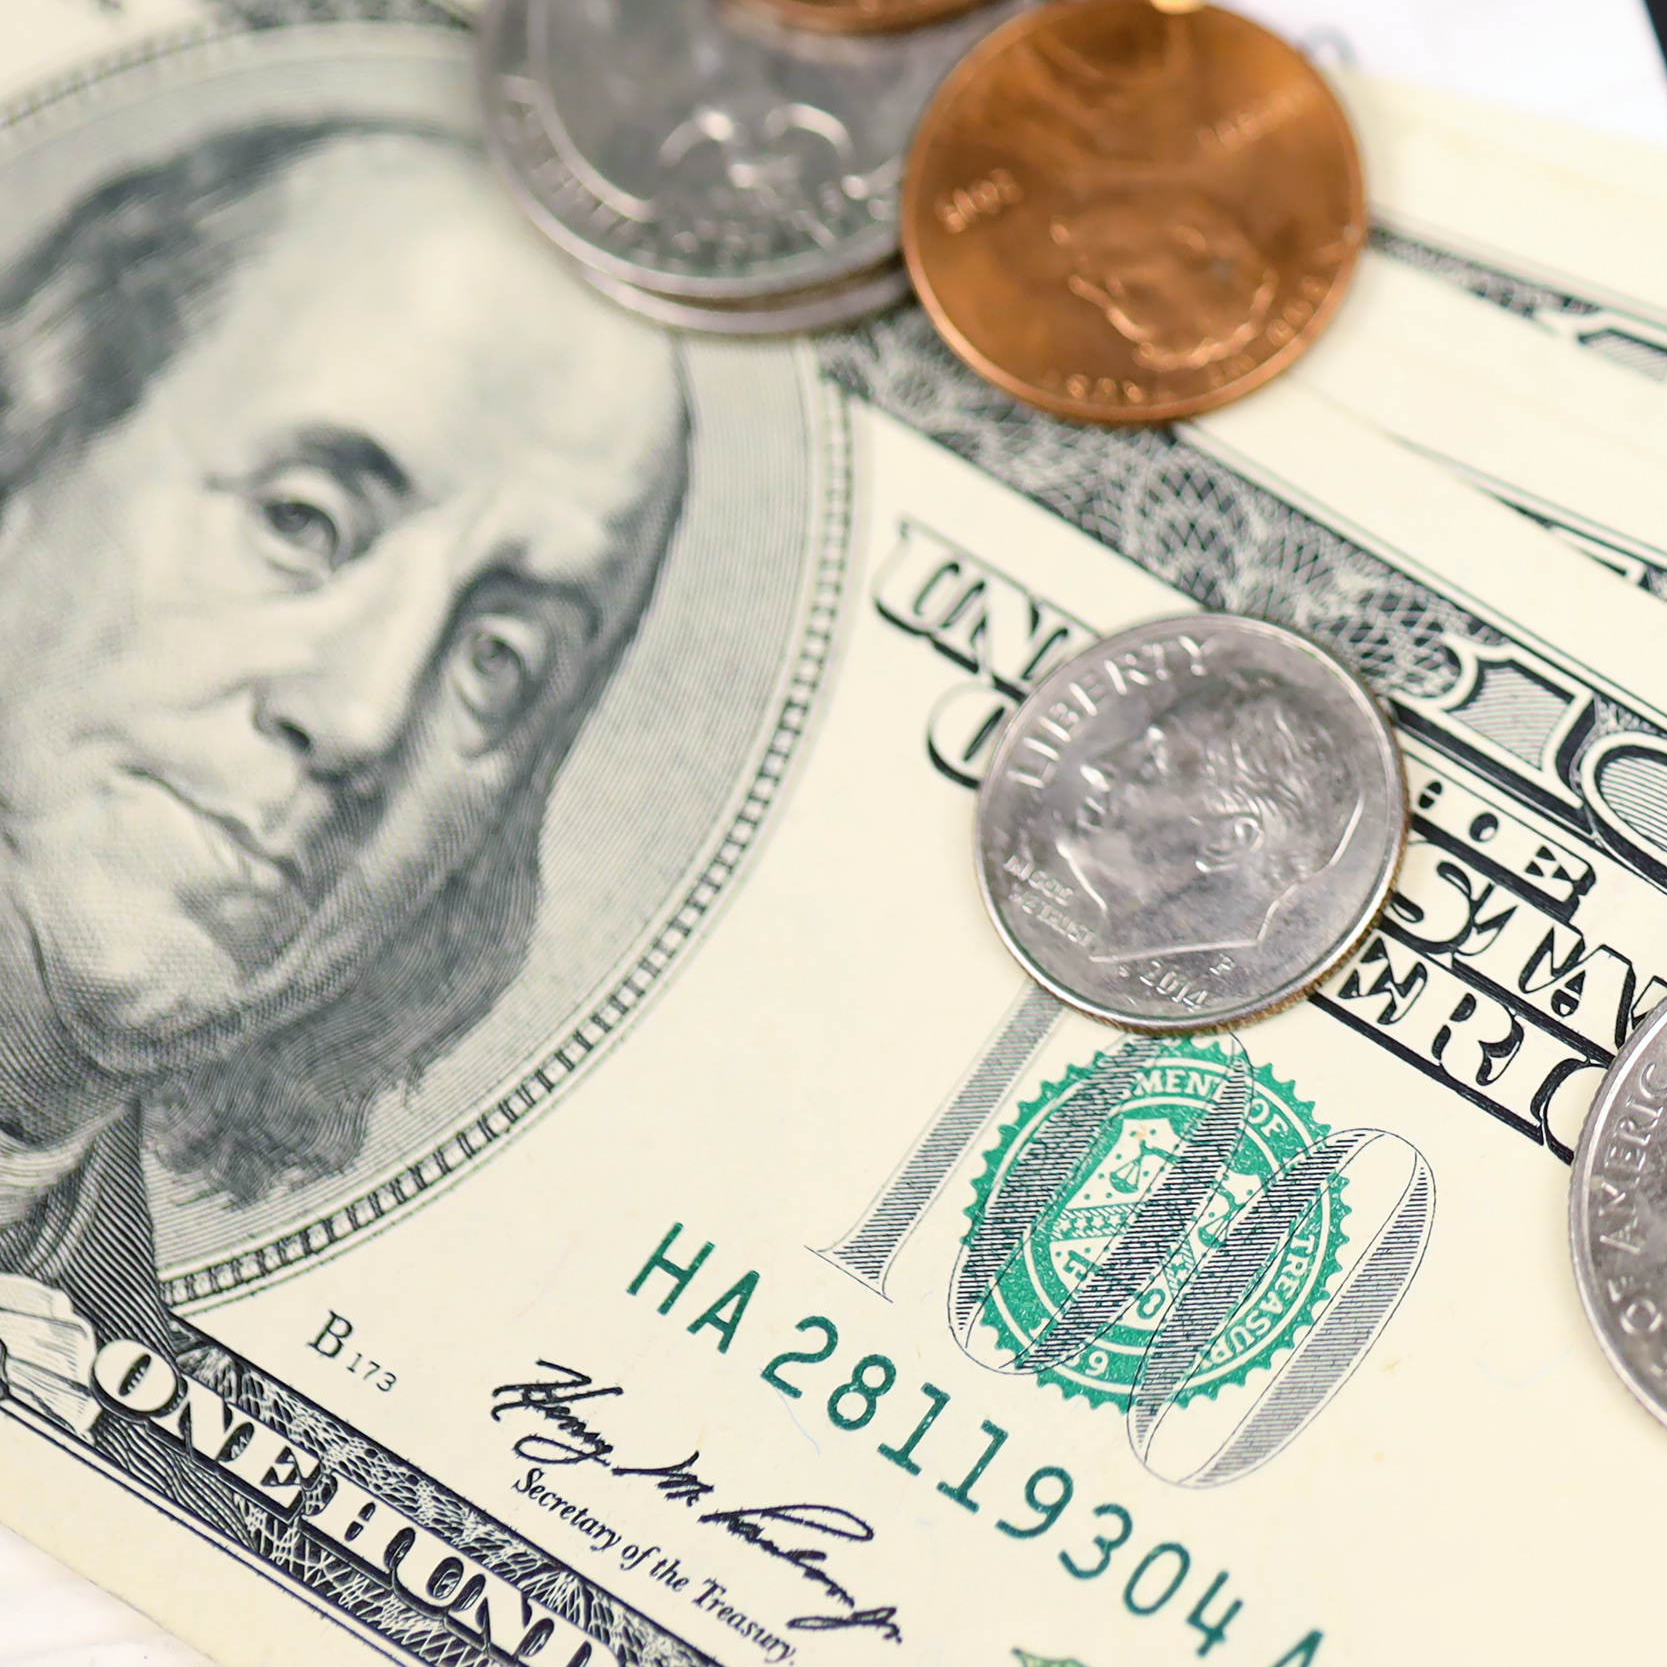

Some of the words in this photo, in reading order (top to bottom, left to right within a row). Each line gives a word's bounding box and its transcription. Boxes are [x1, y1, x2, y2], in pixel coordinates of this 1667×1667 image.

[1007, 635, 1220, 790] LIBERTY
[1138, 959, 1209, 1014] 2014
[87, 1337, 326, 1524] ONE
[510, 1466, 623, 1551] Secretary
[618, 1541, 662, 1573] of
[652, 1546, 692, 1593] the
[690, 1575, 799, 1667] Treasury.
